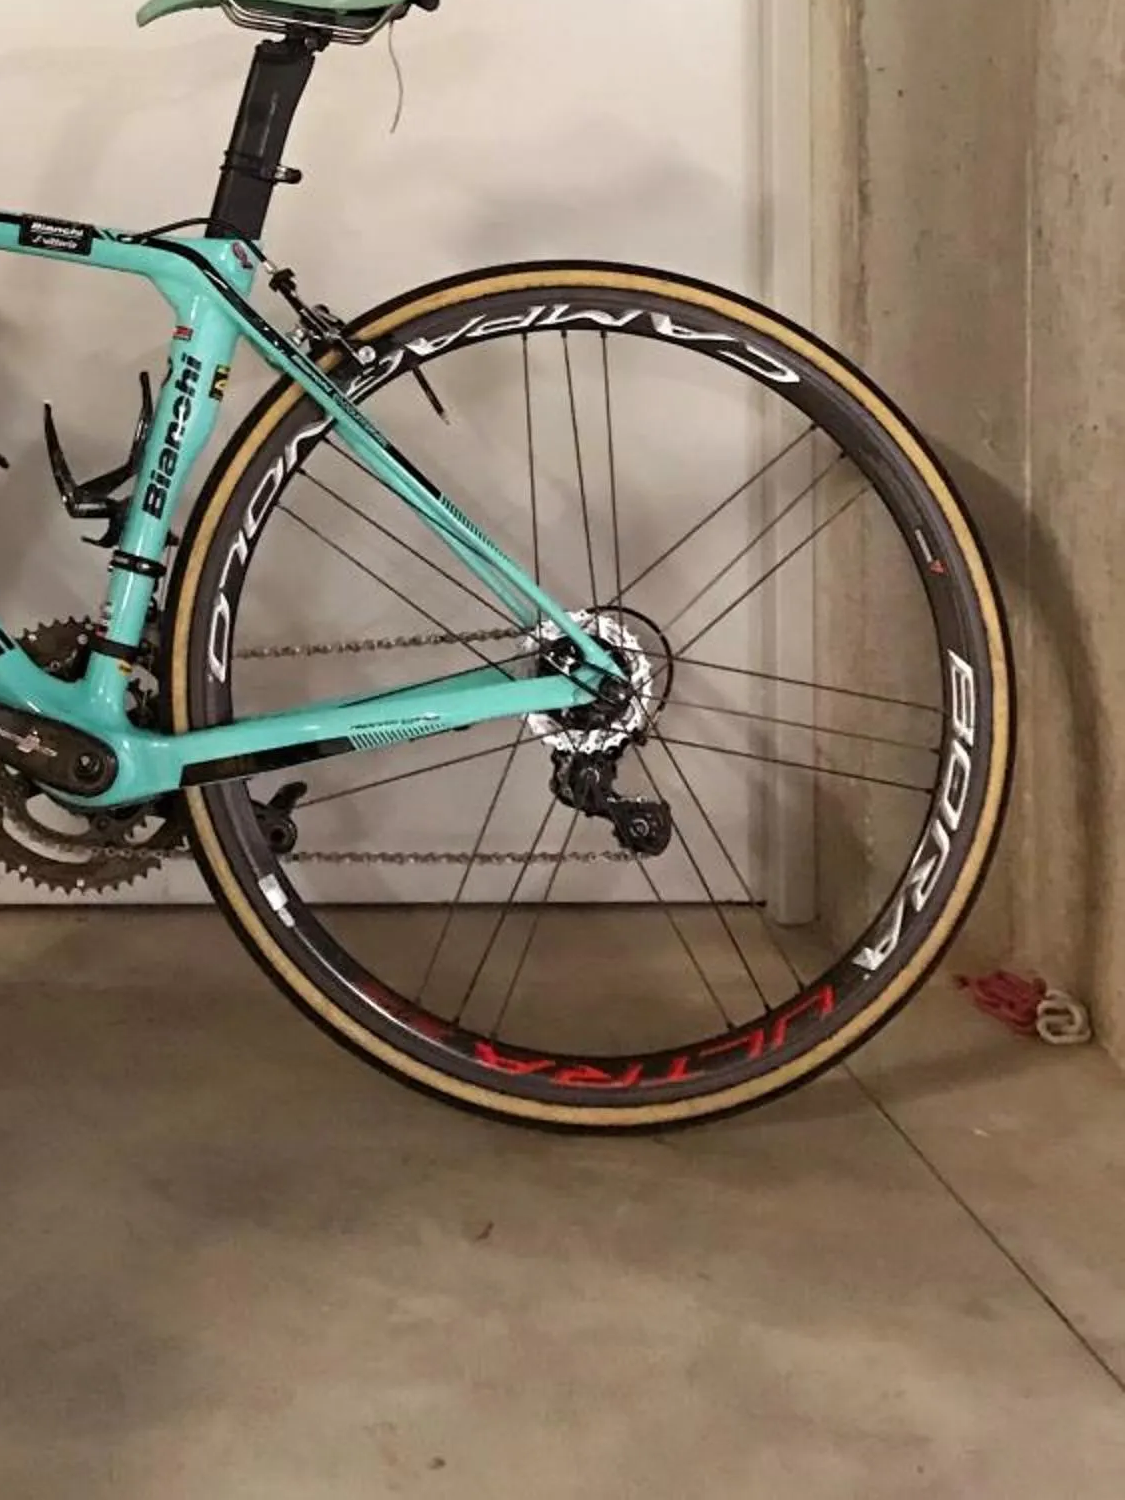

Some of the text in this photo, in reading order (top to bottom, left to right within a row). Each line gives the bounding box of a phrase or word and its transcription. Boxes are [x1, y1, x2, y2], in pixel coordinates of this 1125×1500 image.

[142, 352, 202, 520] Bianchi
[852, 649, 976, 972] BORA
[474, 984, 836, 1089] ULTRA
